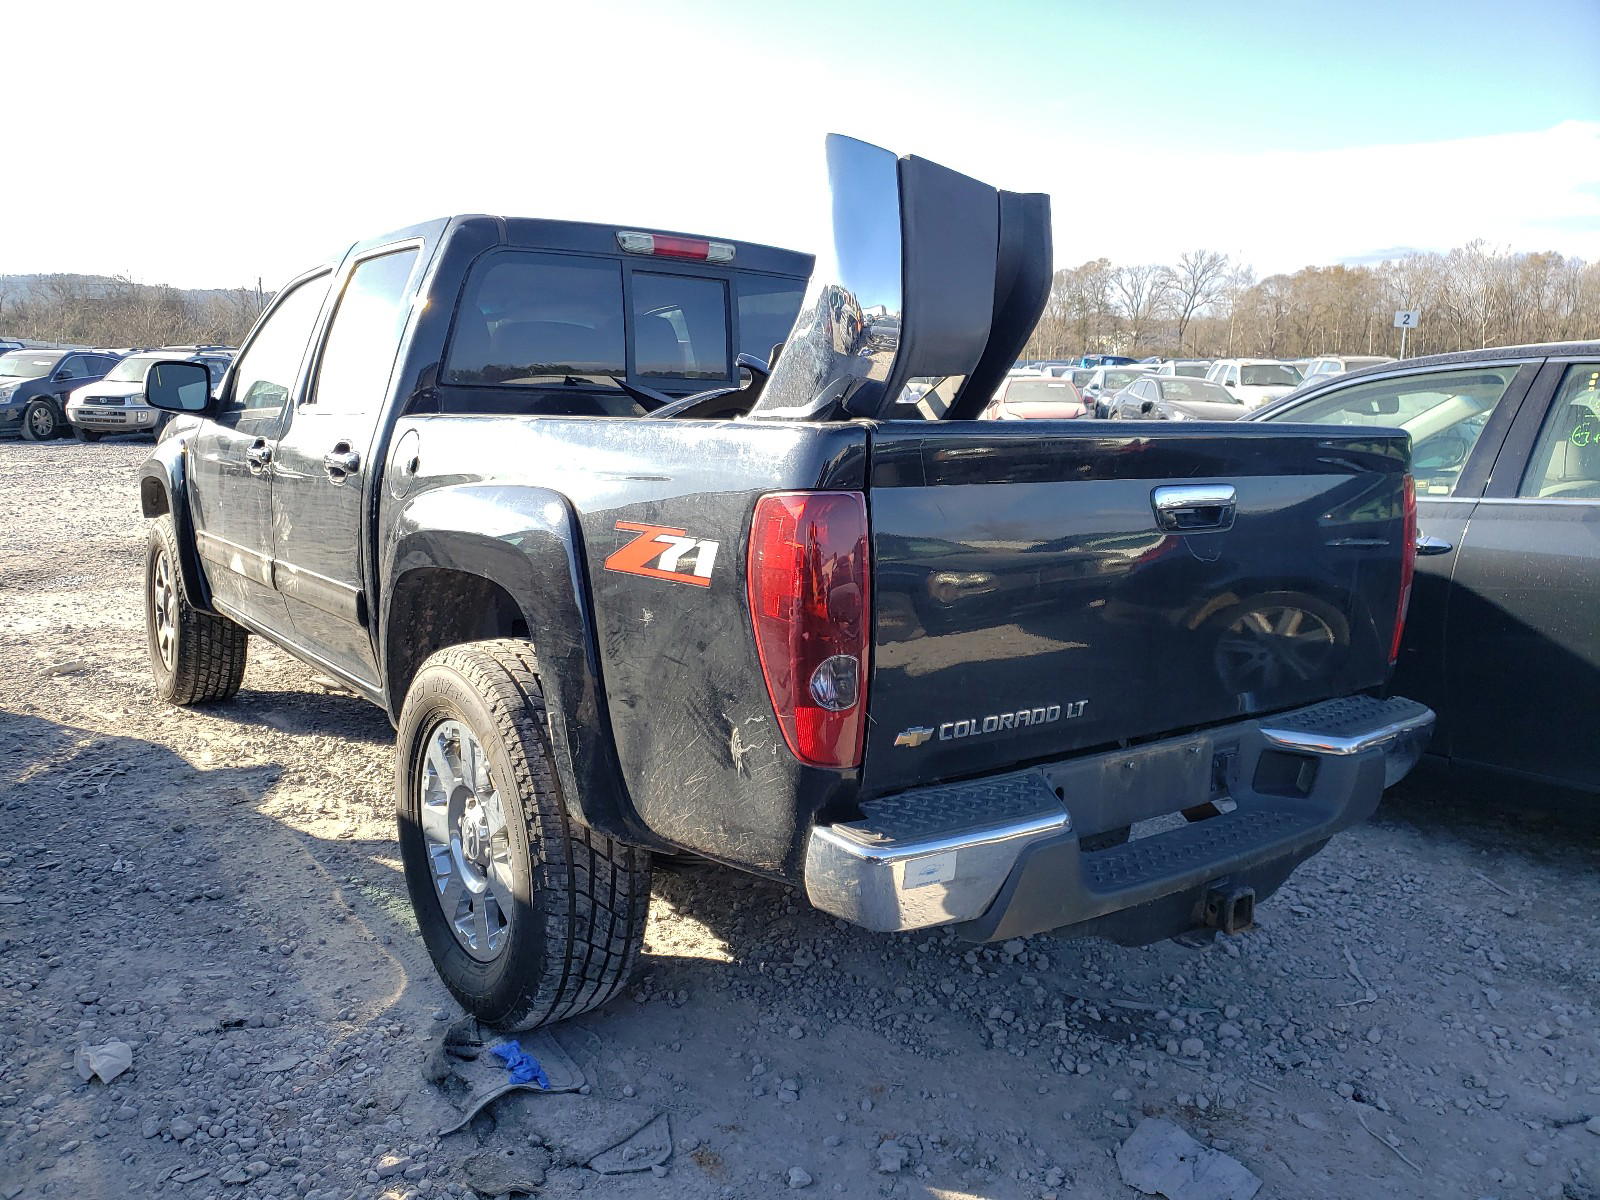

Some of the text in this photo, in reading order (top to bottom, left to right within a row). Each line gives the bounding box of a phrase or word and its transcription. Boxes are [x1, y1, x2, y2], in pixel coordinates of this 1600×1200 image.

[1402, 313, 1410, 325] 2
[603, 519, 720, 589] Z71
[938, 699, 1089, 741] COLORADO LT
